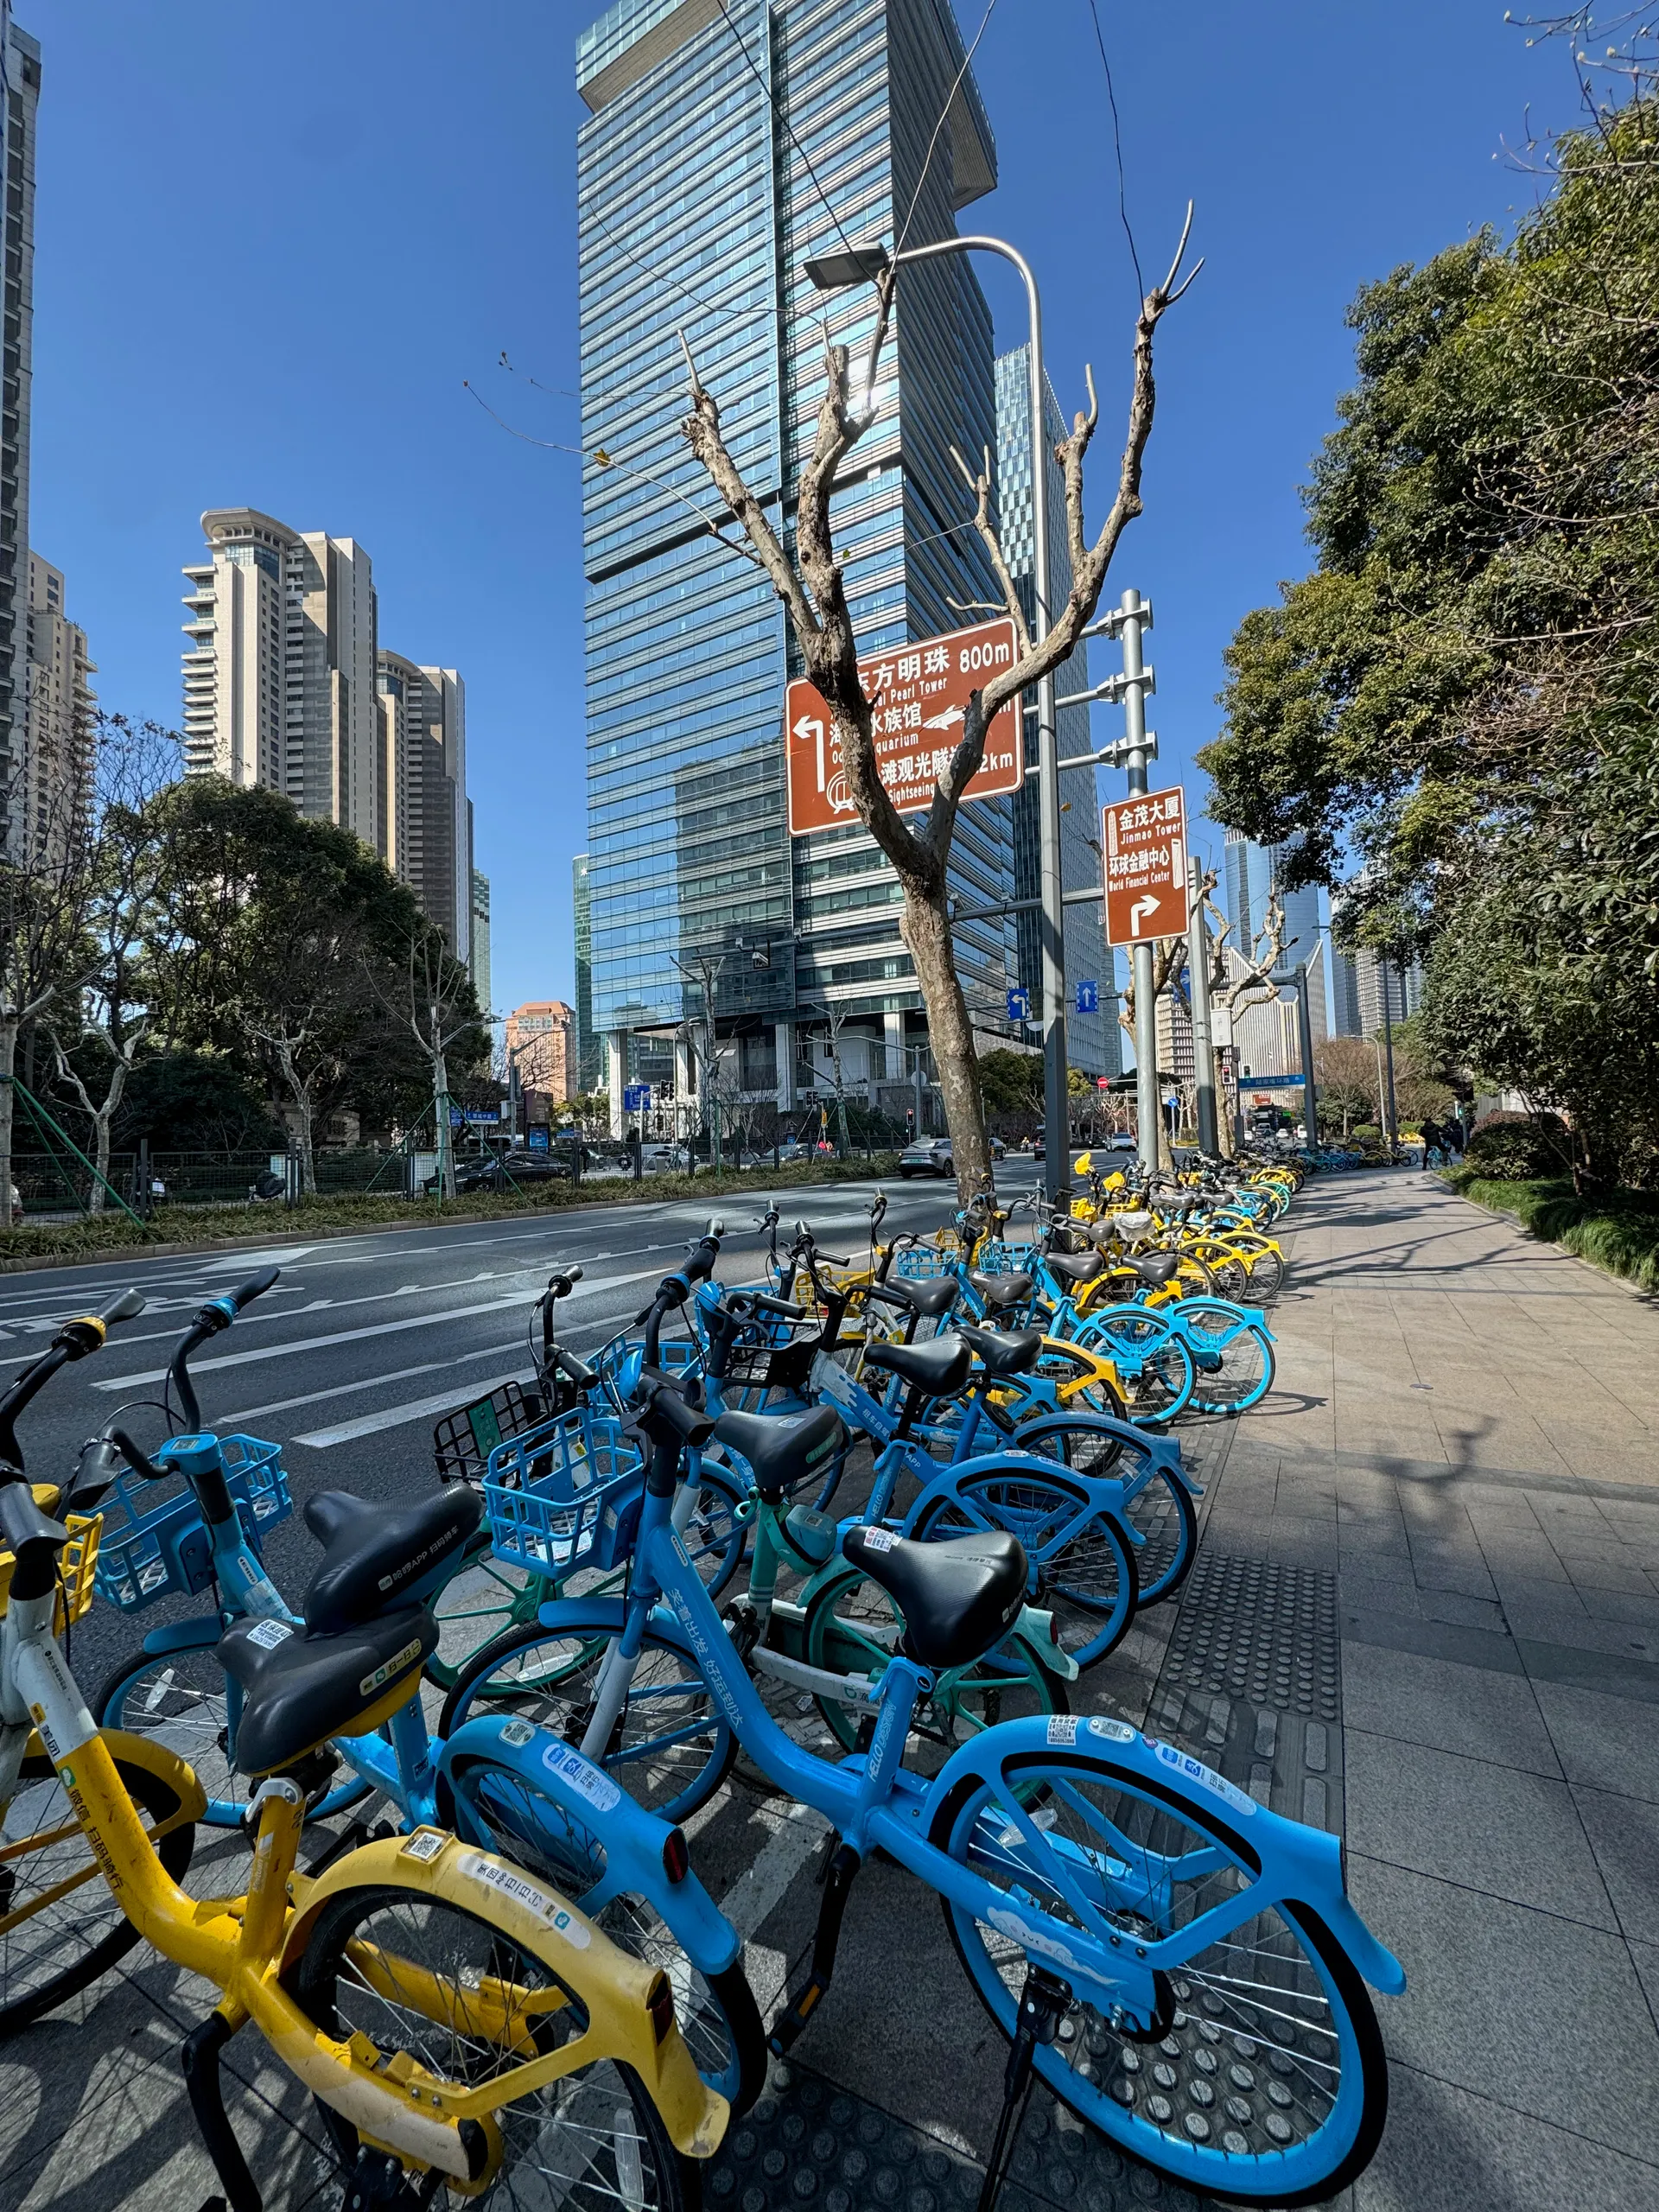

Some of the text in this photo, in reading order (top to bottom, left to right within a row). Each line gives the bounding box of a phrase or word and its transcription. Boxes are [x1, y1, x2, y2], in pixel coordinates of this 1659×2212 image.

[959, 641, 1009, 674] 800m
[891, 686, 915, 703] Pearl
[919, 677, 948, 696] Tower
[876, 733, 918, 757] quarium
[889, 784, 935, 805] Sightseeing
[1119, 795, 1181, 831] 金茂大厦
[1121, 823, 1181, 845] Jinmao Tower
[1109, 845, 1170, 877] 环球金融中心
[1109, 871, 1170, 892] World Financial Center
[871, 1495, 884, 1518] HELLO
[668, 1588, 709, 1656] 笑着出发
[388, 1649, 411, 1674] 扫一扫
[868, 1744, 884, 1783] HELLO
[69, 1789, 124, 1891] 微信 扫码骑行
